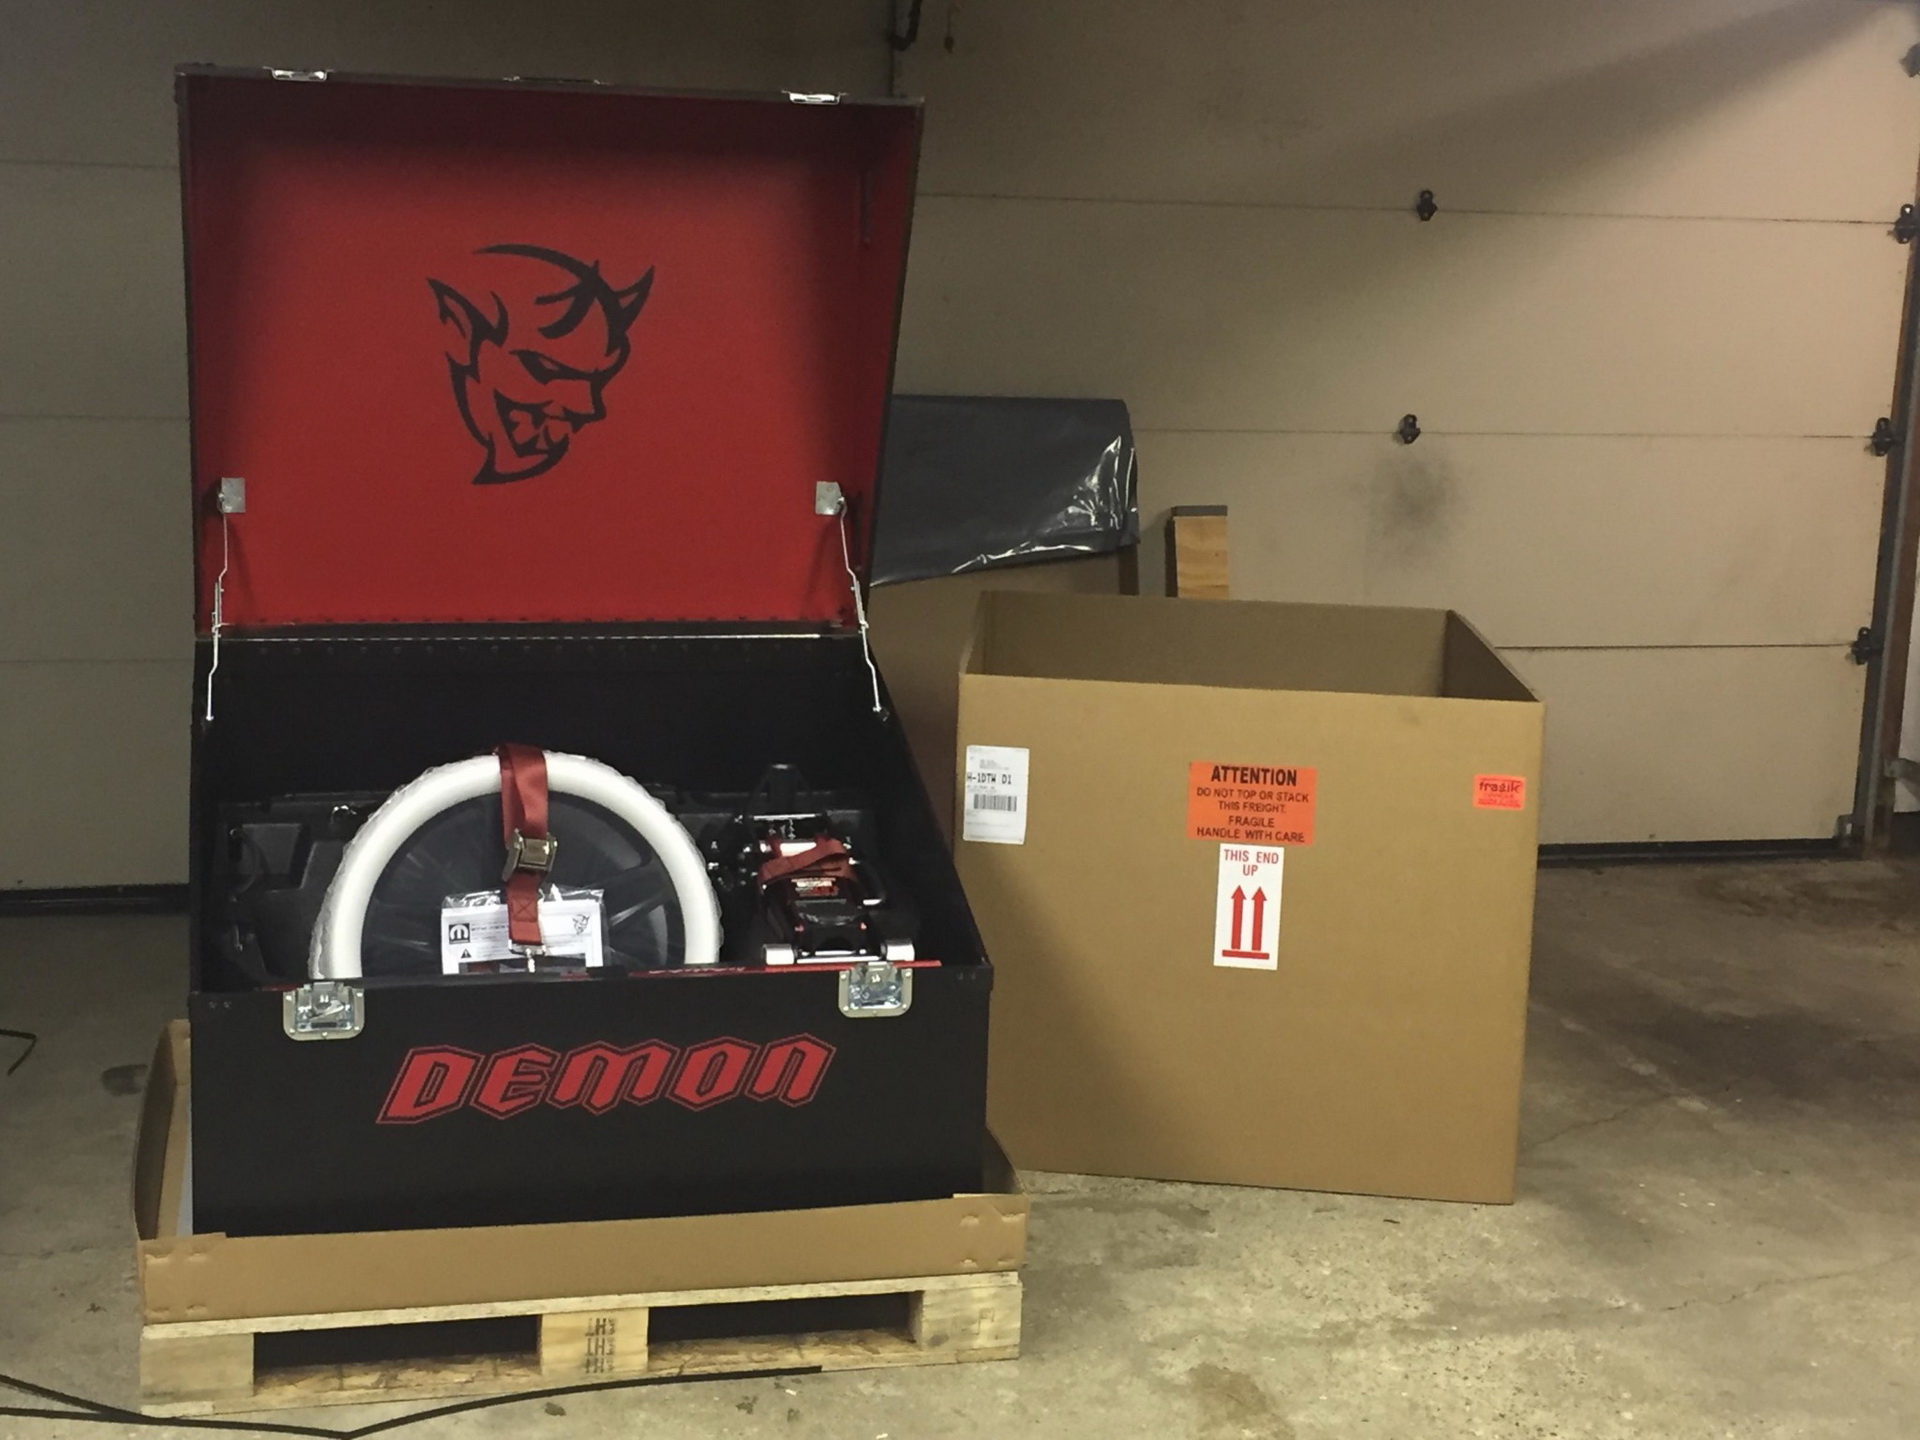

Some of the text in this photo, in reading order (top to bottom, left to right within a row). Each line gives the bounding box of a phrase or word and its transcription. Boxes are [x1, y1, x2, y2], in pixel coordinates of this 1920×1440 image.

[1211, 766, 1297, 786] ATTENTION
[1197, 787, 1309, 802] DO NOT TOP OR STACK
[1218, 800, 1240, 811] THIS
[1228, 815, 1275, 828] FRAGILE
[1197, 827, 1305, 843] HANDLE WITH CARE
[1224, 848, 1279, 865] THIS END
[1242, 863, 1259, 876] UP
[376, 1032, 837, 1125] DEMON
